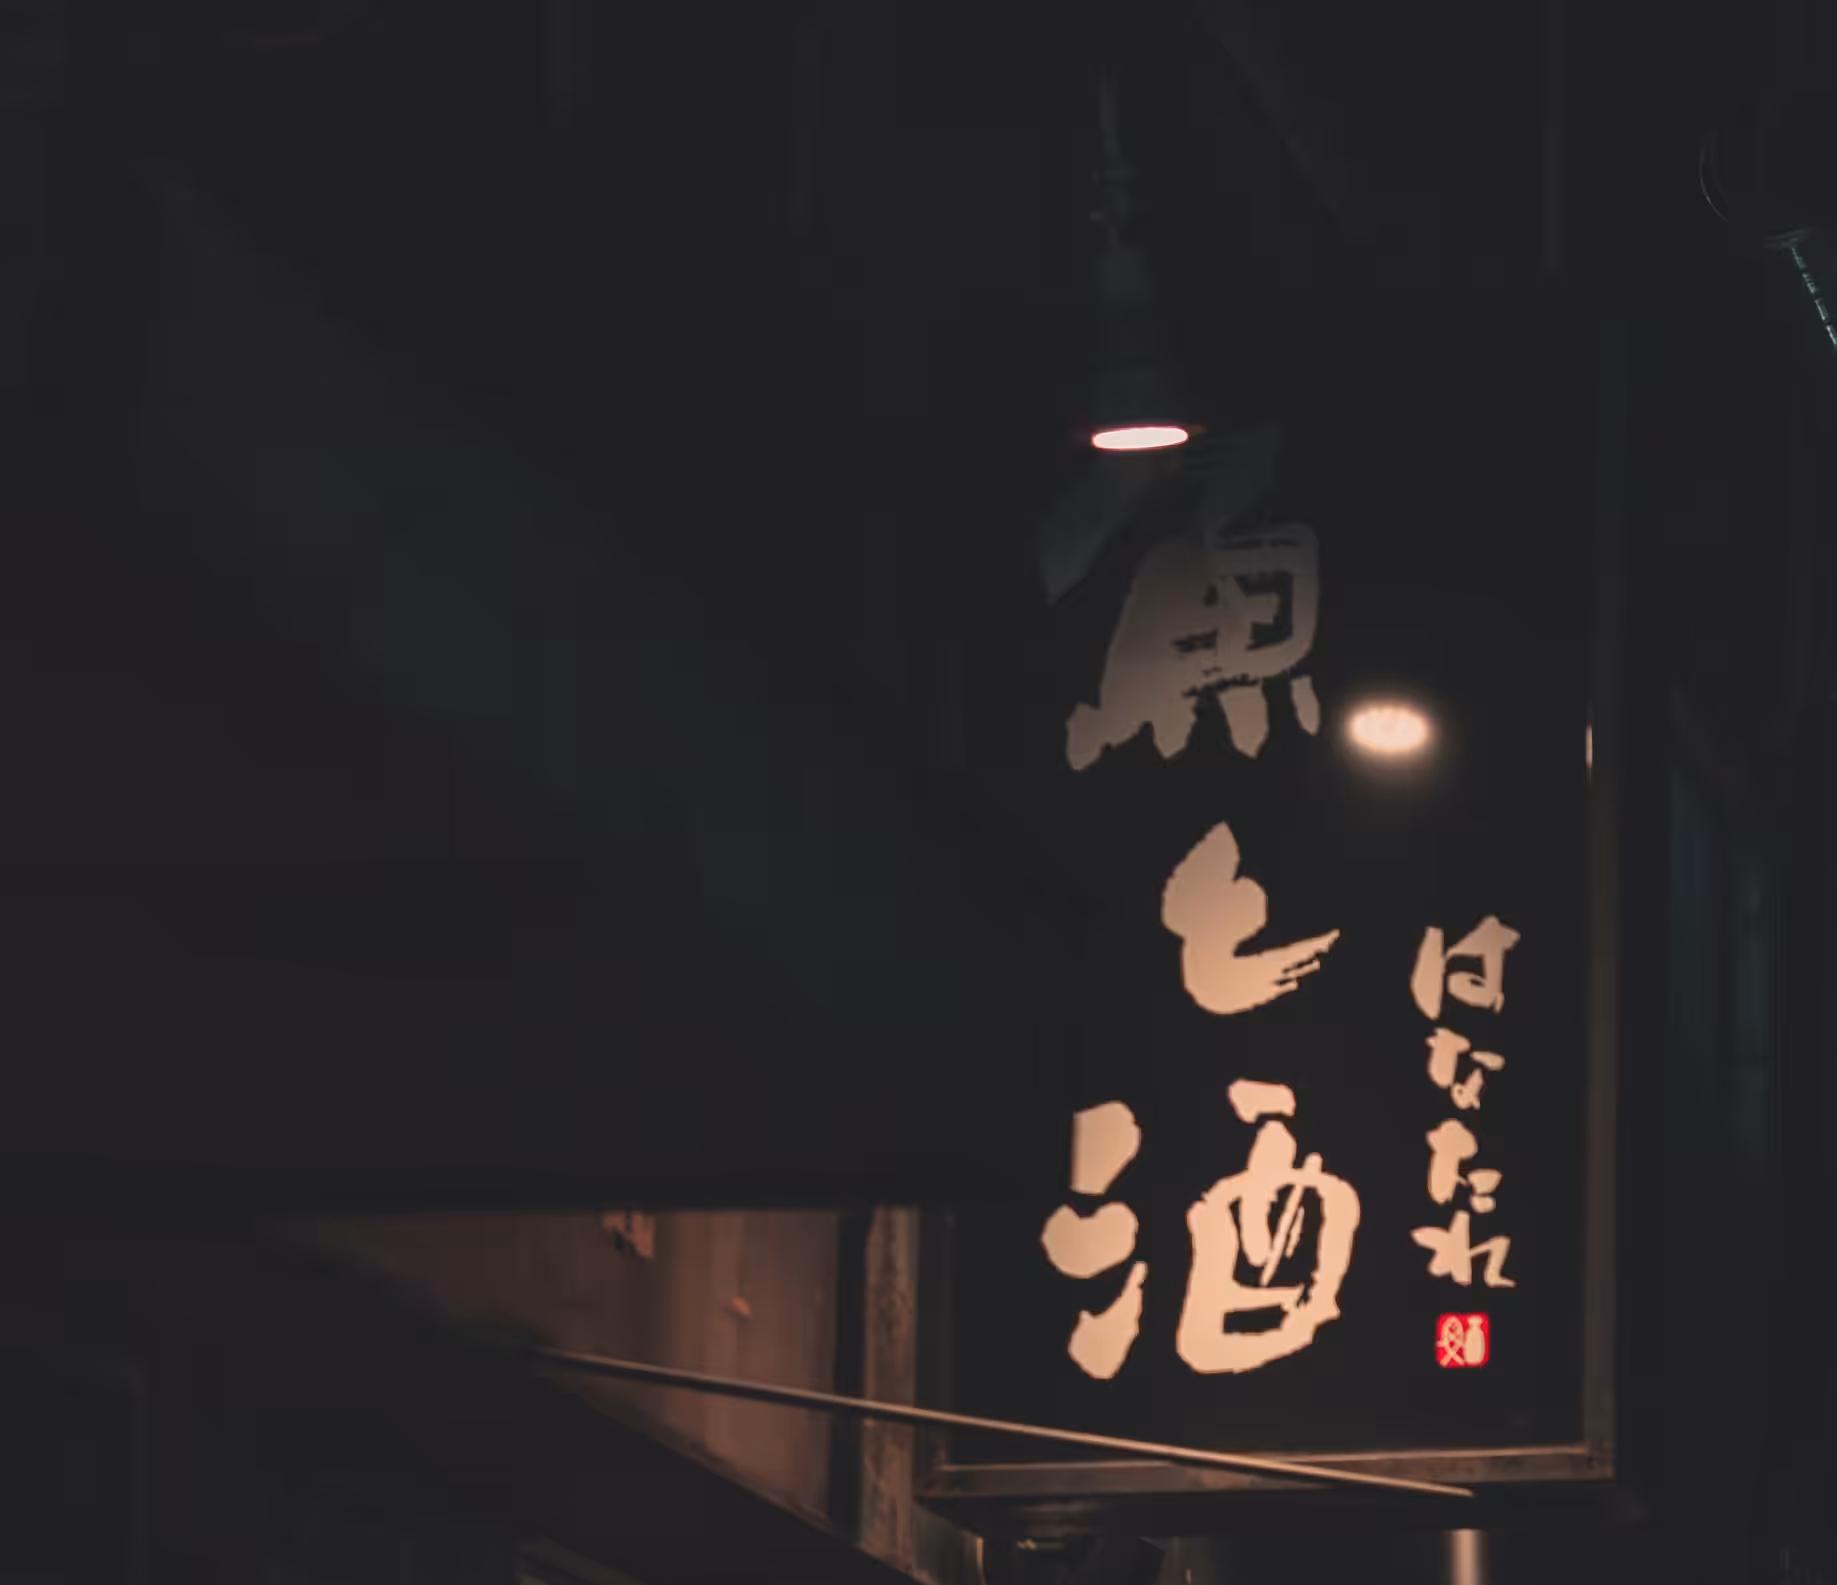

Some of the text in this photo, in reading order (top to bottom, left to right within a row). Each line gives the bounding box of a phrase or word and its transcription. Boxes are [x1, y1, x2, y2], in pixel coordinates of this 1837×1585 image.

[1037, 424, 1361, 1380] 魚と酒
[1409, 914, 1520, 1288] はなたれ
